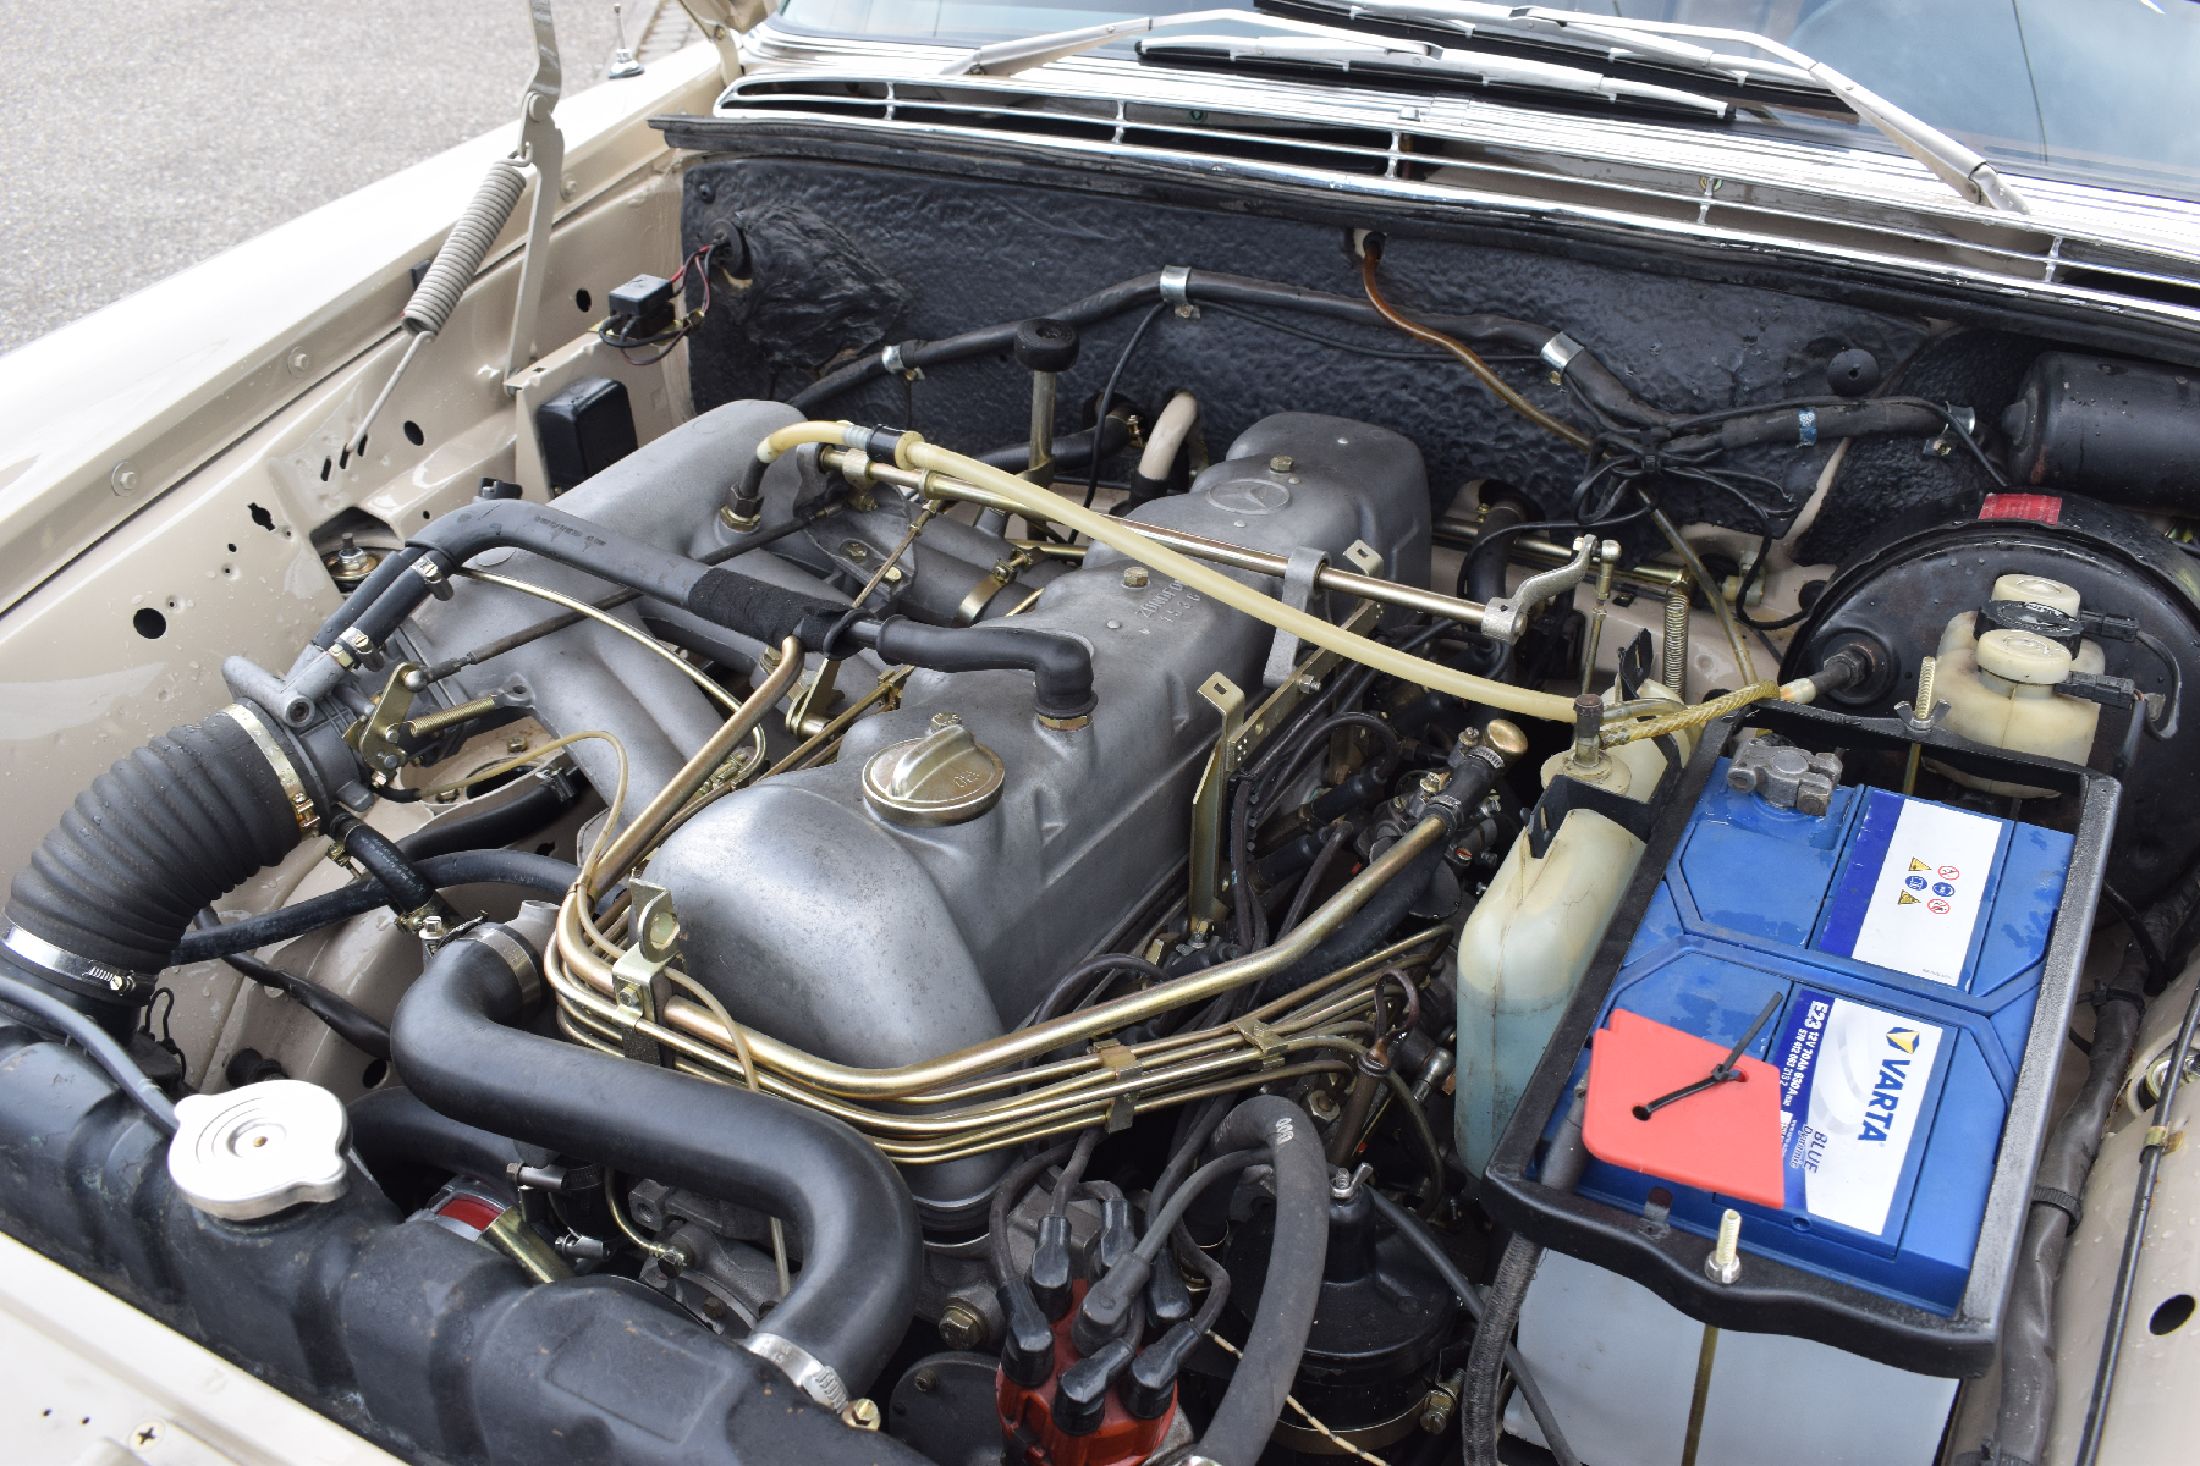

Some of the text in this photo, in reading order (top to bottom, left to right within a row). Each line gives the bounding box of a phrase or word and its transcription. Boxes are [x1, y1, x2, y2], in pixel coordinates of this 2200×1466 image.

[1804, 1000, 1829, 1030] E23
[1805, 1031, 1820, 1048] 12V
[1857, 1059, 1911, 1142] VARTA
[1803, 1130, 1829, 1174] BLUE
